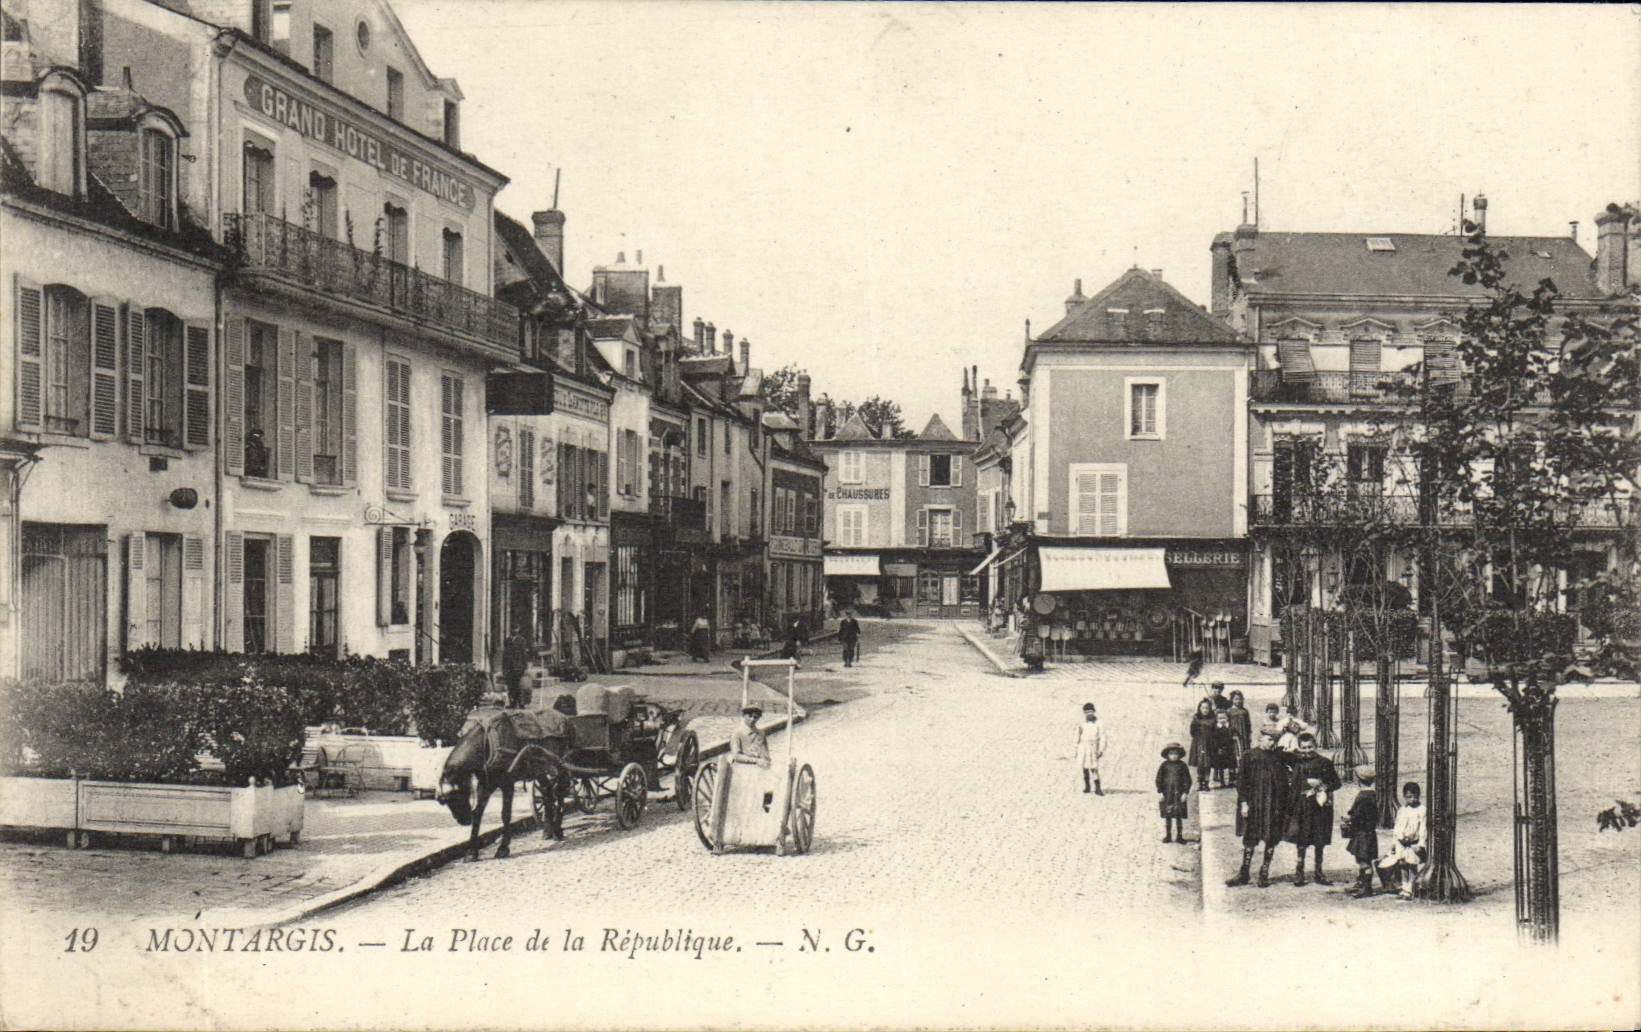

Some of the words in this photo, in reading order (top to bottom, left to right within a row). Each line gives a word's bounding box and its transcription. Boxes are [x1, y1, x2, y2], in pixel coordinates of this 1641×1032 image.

[260, 84, 326, 142] GRAND
[333, 121, 386, 170] HOTEL
[391, 154, 408, 180] DE
[412, 160, 467, 208] FRANCE
[836, 486, 890, 500] CHAUSSURES
